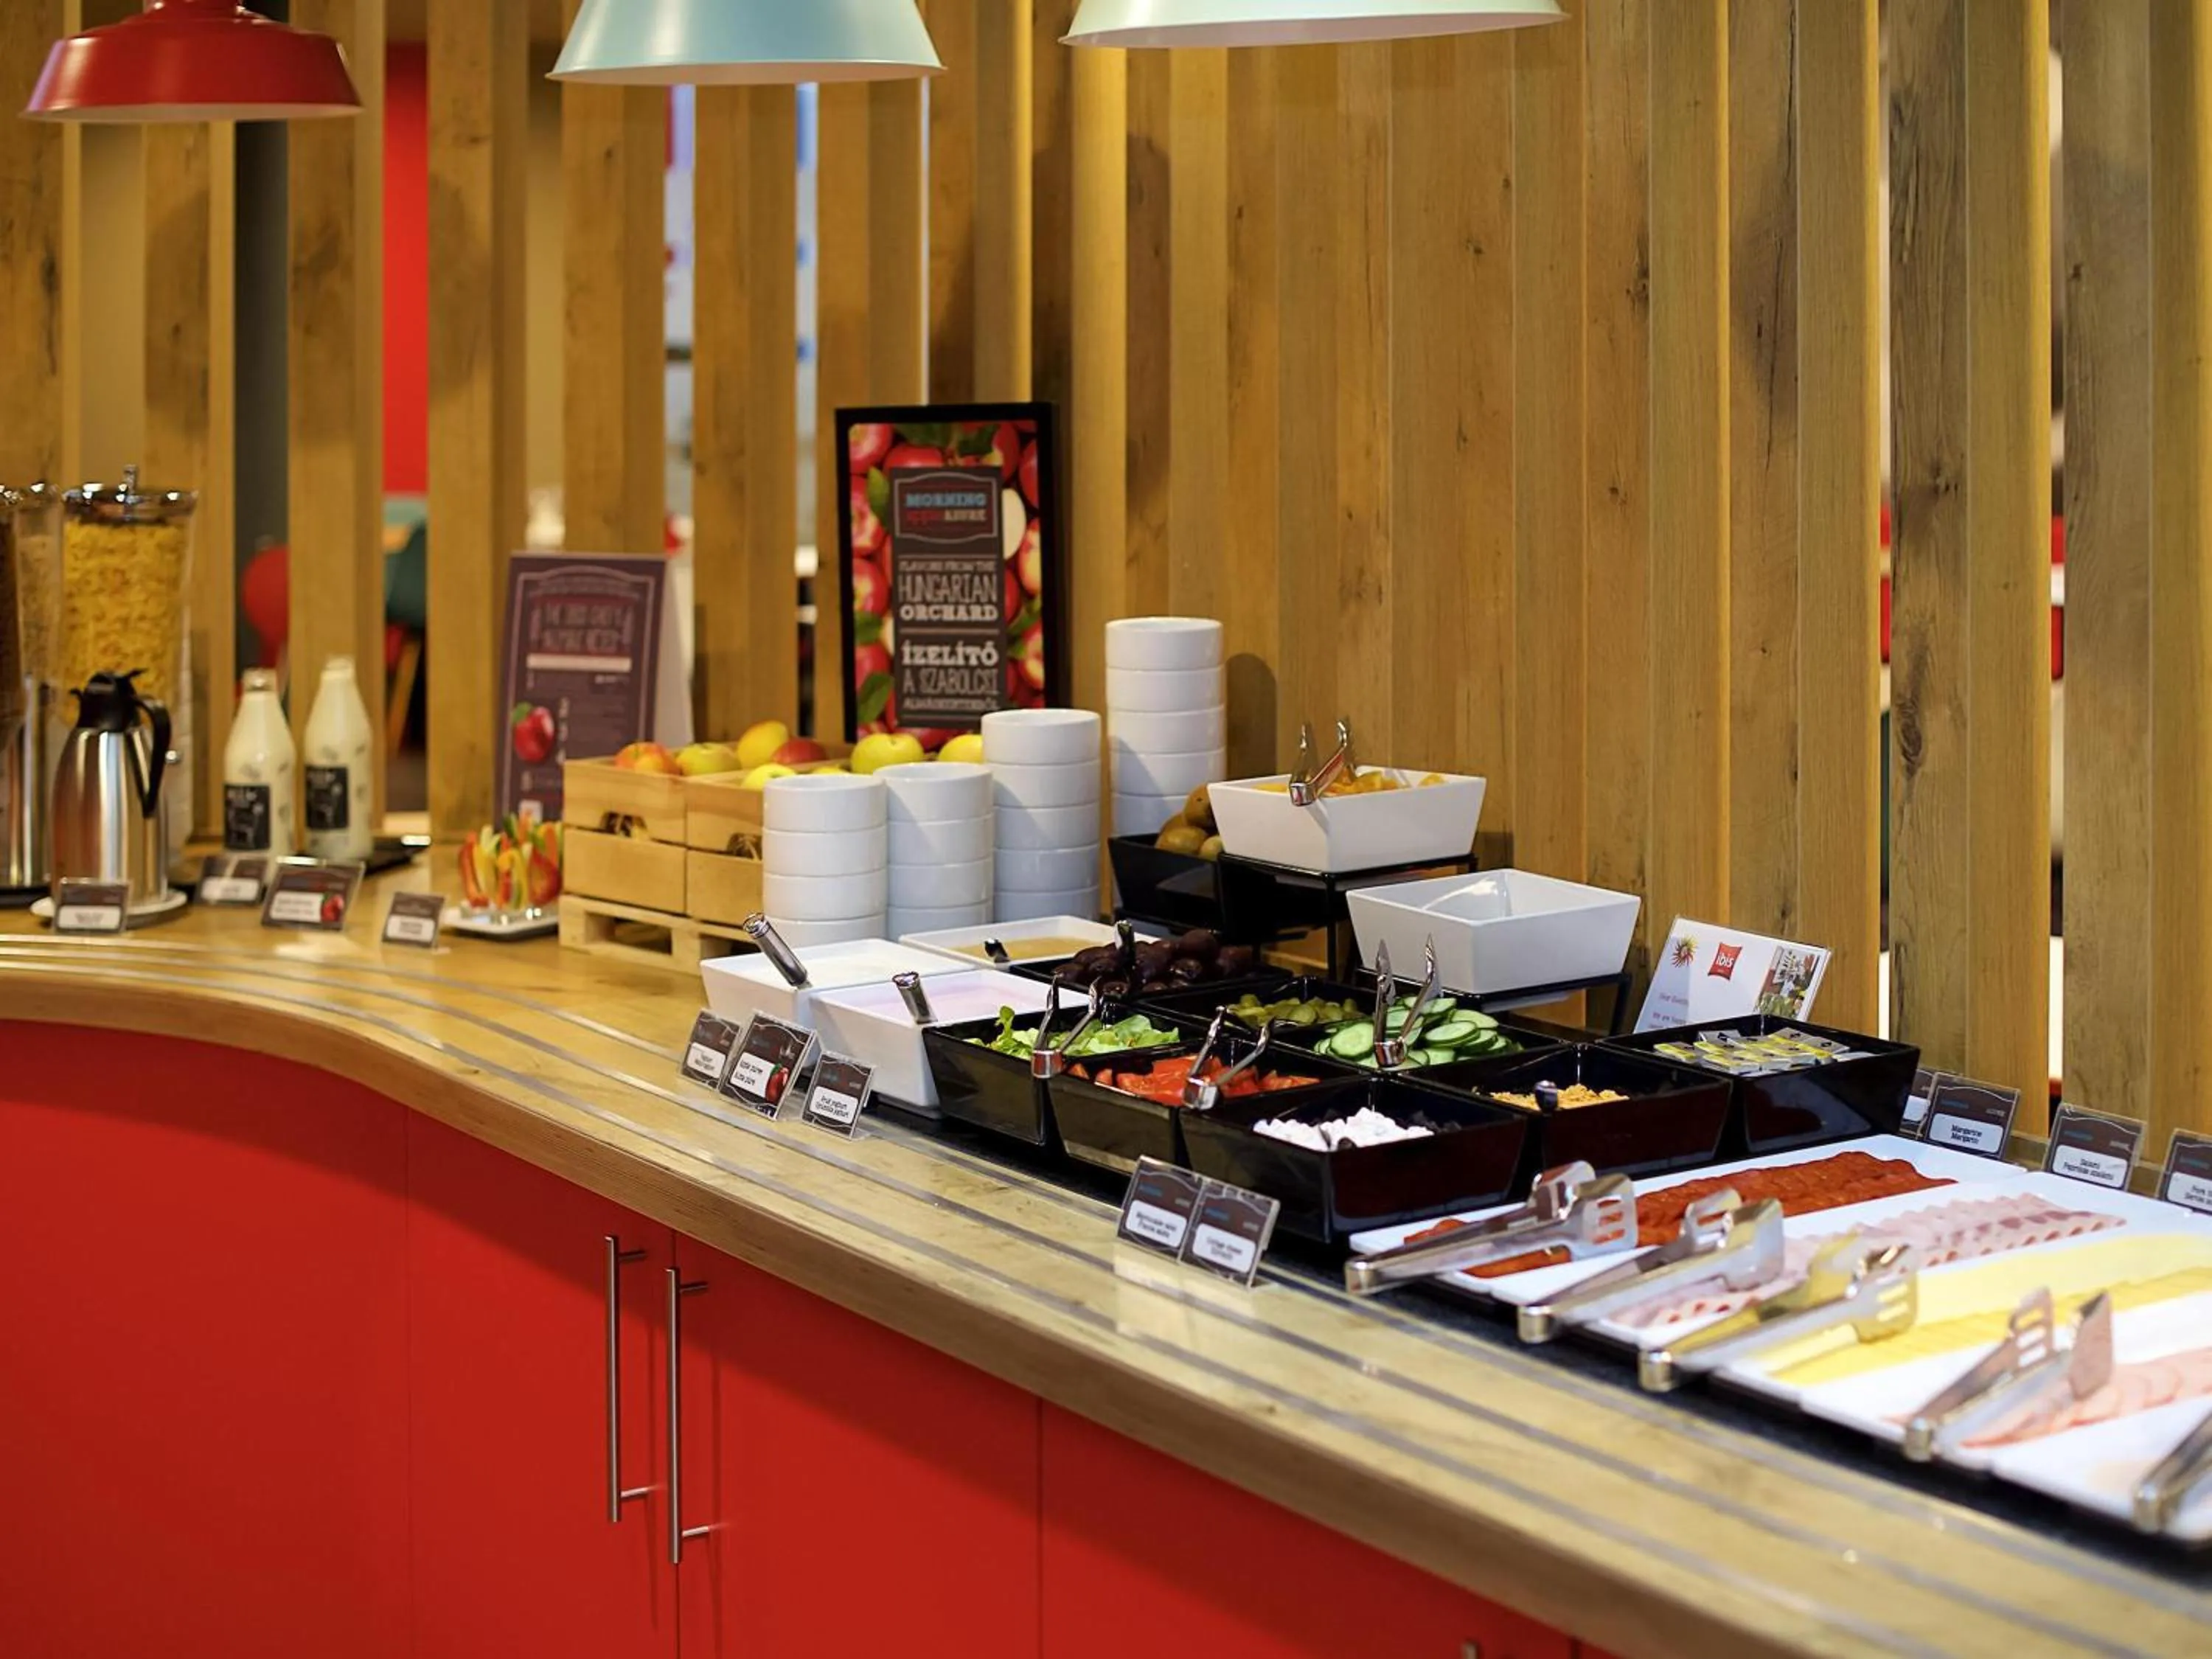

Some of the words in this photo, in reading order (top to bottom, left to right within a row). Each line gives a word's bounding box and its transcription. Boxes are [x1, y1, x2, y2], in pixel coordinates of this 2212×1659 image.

[905, 493, 987, 507] MORNING
[898, 574, 997, 603] HUNGARIAN
[900, 603, 998, 621] ORCHARD
[903, 668, 915, 694] A
[1715, 952, 1734, 967] ibis
[1951, 1124, 1983, 1138] Margarine
